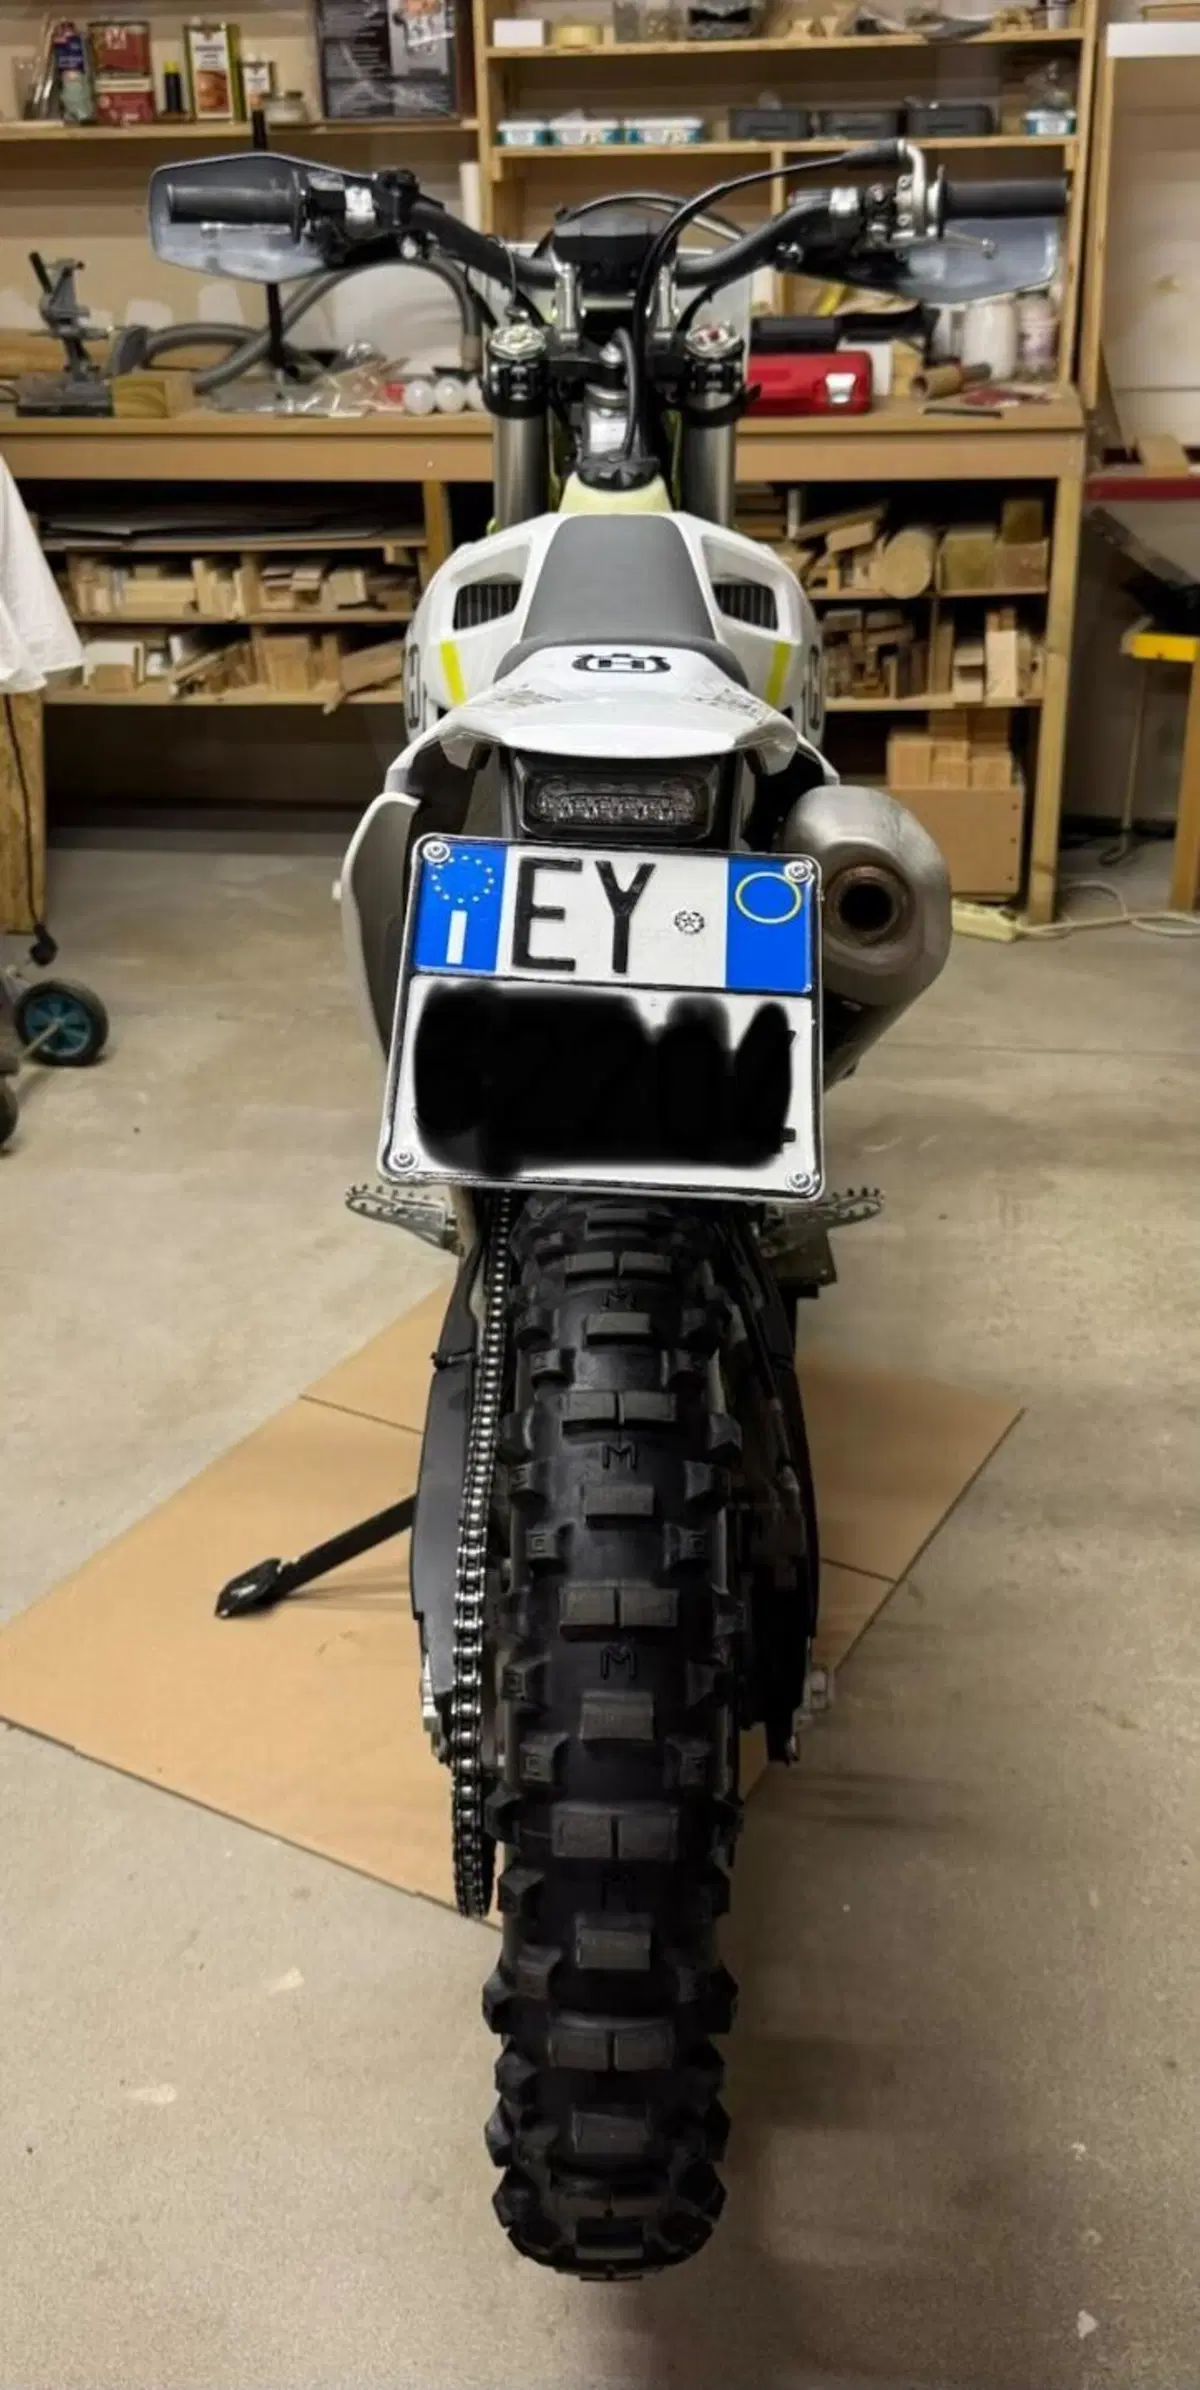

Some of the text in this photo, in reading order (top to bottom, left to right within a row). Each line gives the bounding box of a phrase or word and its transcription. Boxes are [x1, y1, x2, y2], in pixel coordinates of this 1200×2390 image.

[445, 910, 467, 964] I
[511, 857, 656, 973] EY
[602, 1441, 637, 1470] M
[600, 1642, 637, 1680] M
